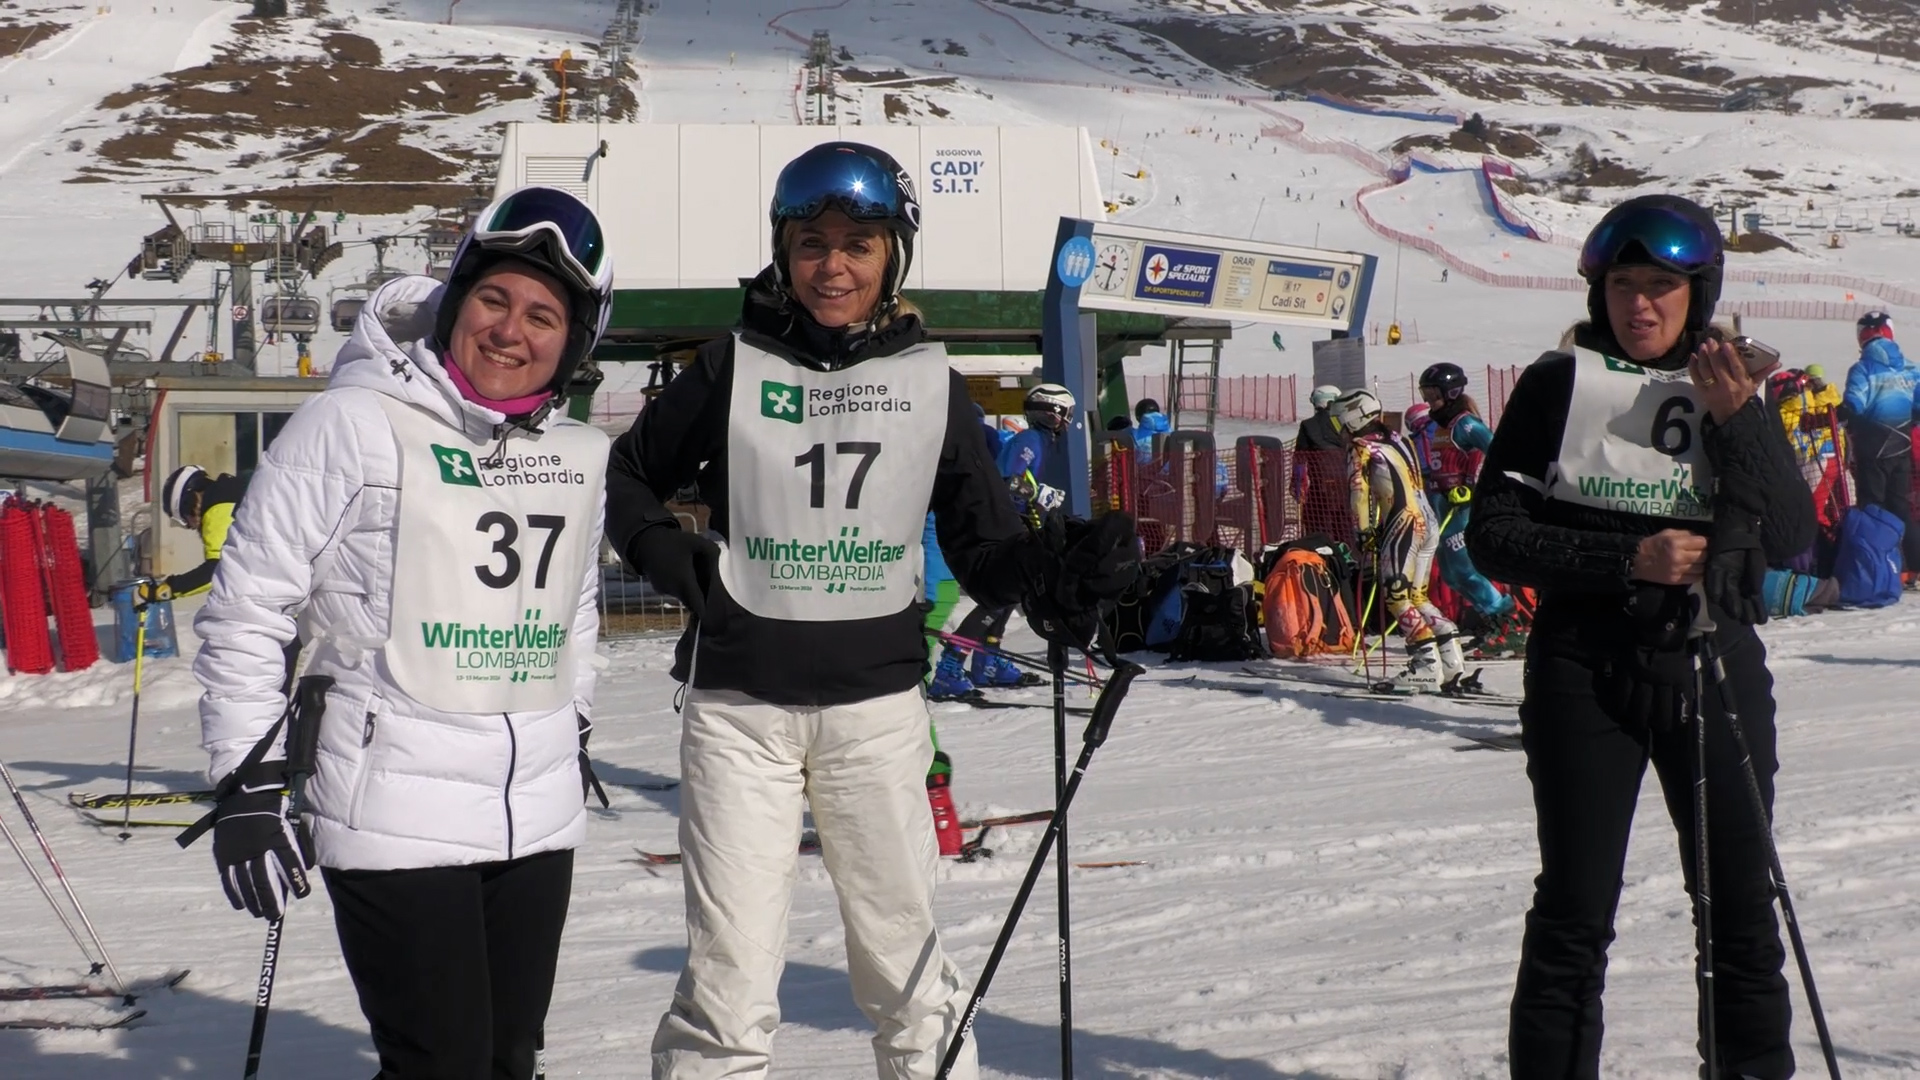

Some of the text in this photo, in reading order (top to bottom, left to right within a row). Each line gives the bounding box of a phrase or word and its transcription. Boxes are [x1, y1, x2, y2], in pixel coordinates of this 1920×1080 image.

[930, 161, 984, 176] CADI'
[932, 178, 979, 193] S.I.T.
[1183, 264, 1213, 275] SPORT
[1232, 256, 1256, 267] ORARI
[1167, 271, 1211, 283] SPECIALIST
[1293, 283, 1302, 292] 17
[1293, 297, 1306, 309] Sit
[809, 383, 888, 402] Regione
[809, 397, 911, 417] Lombardia
[1651, 396, 1695, 457] 6
[477, 454, 562, 472] Regione
[482, 469, 585, 487] Lombardia
[794, 441, 882, 510] 17
[474, 511, 566, 589] 37
[745, 536, 906, 564] WinterWelfare
[770, 563, 885, 581] LOMBARDIA
[1059, 937, 1067, 983] ATOMIC
[960, 996, 983, 1040] ATOMIC
